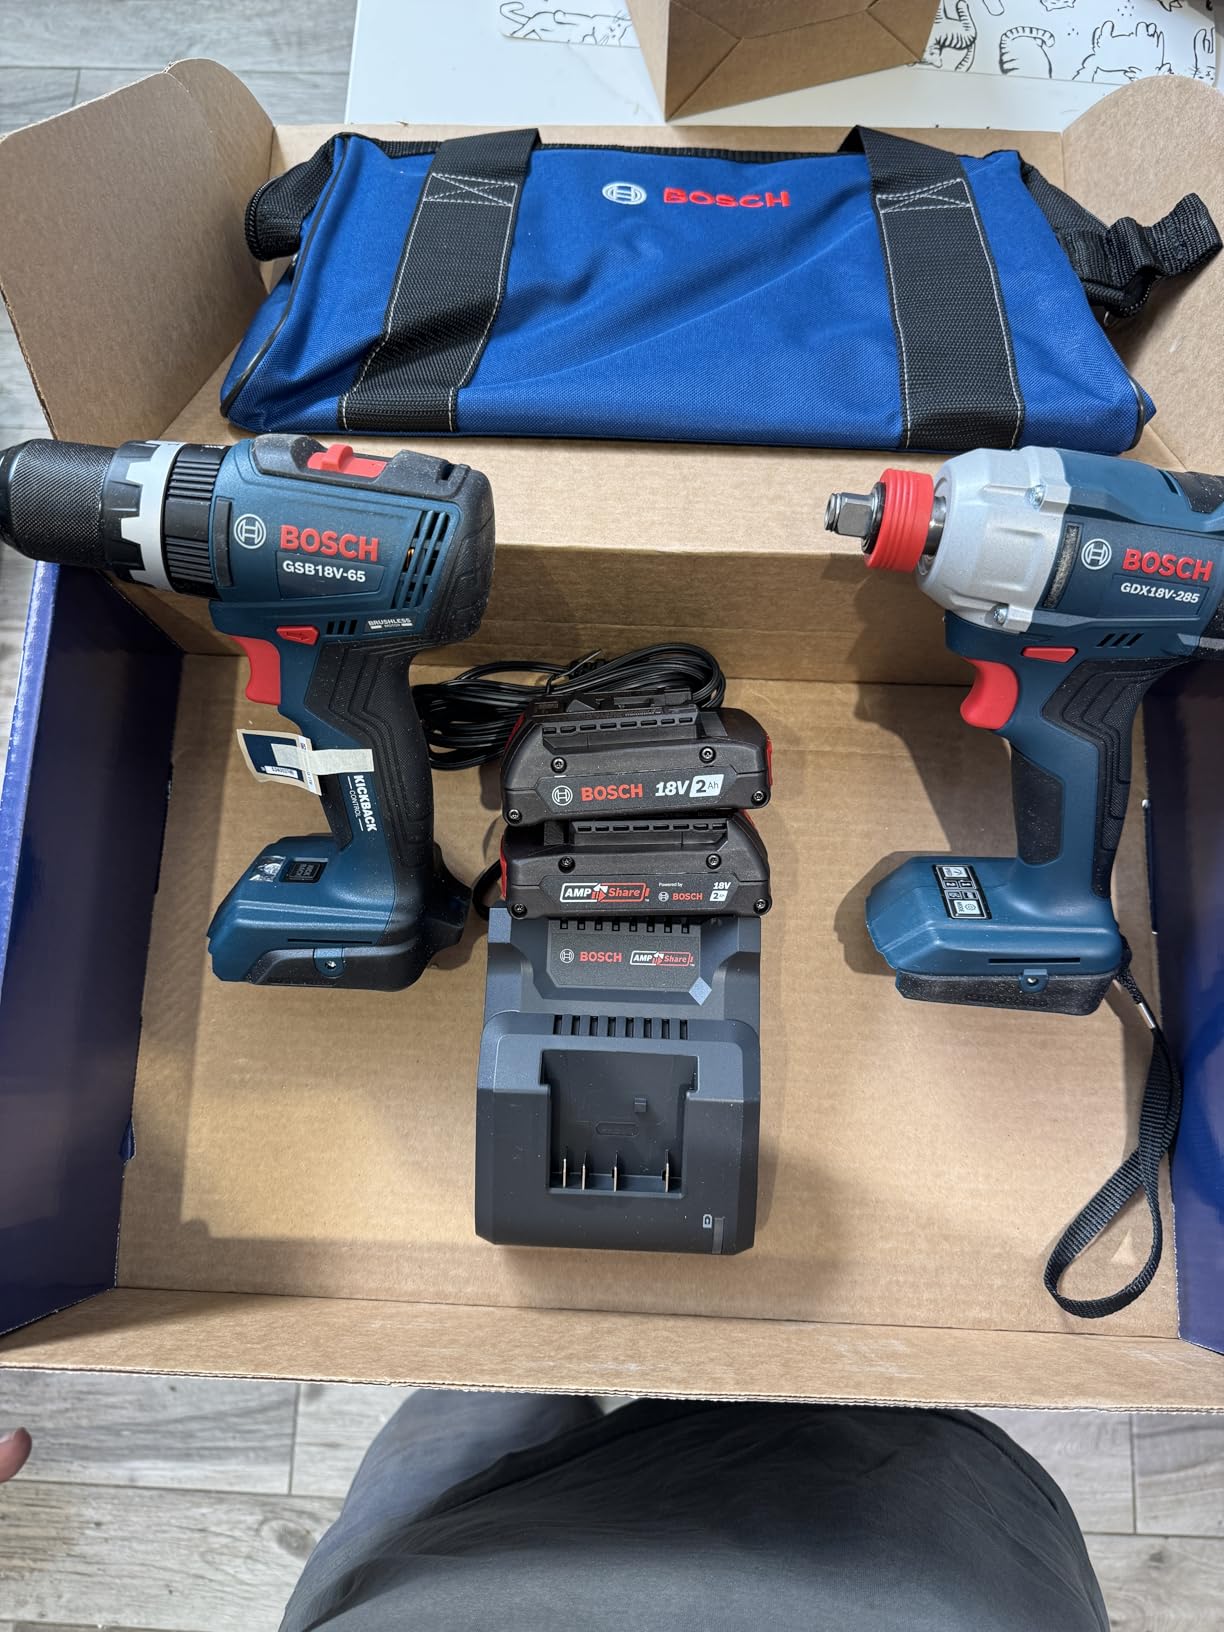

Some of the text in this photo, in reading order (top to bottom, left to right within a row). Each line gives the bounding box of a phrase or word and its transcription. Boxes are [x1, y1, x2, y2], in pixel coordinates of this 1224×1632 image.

[664, 187, 790, 208] BOSCH
[279, 524, 379, 562] BOSCH
[282, 560, 366, 583] GSB18V-65
[1122, 548, 1214, 582] BOSCH
[1120, 582, 1200, 604] GDX18V-285
[580, 783, 643, 801] BOSCH
[655, 780, 689, 796] 18V
[349, 790, 361, 818] CONTROL
[353, 774, 378, 832] KICKBACK
[564, 887, 592, 897] AMP
[672, 892, 704, 901] BOSCH
[579, 951, 623, 963] BOSCH
[633, 953, 653, 962] AMP
